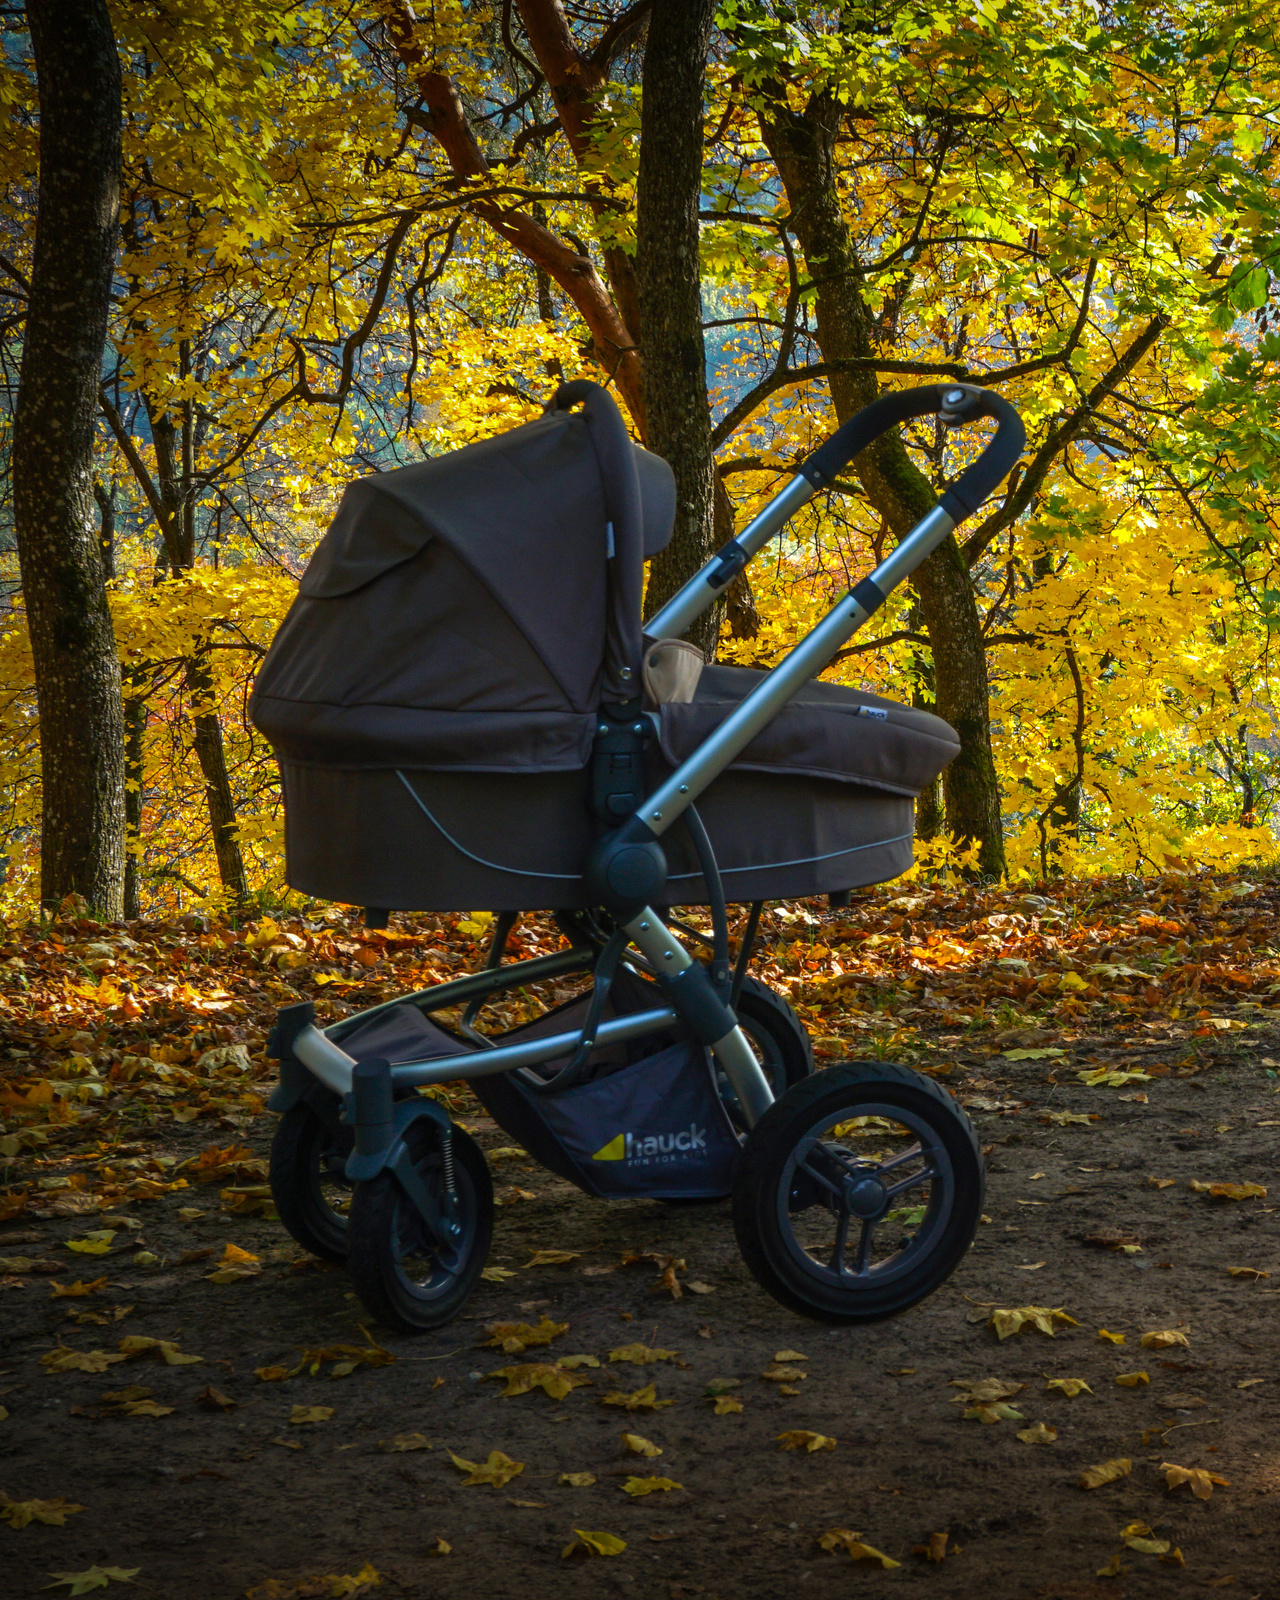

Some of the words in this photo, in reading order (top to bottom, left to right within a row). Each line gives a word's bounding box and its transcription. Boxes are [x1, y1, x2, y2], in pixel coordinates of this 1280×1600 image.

[626, 1123, 707, 1159] hauck
[628, 1159, 649, 1167] FUN
[655, 1155, 676, 1164] FOR
